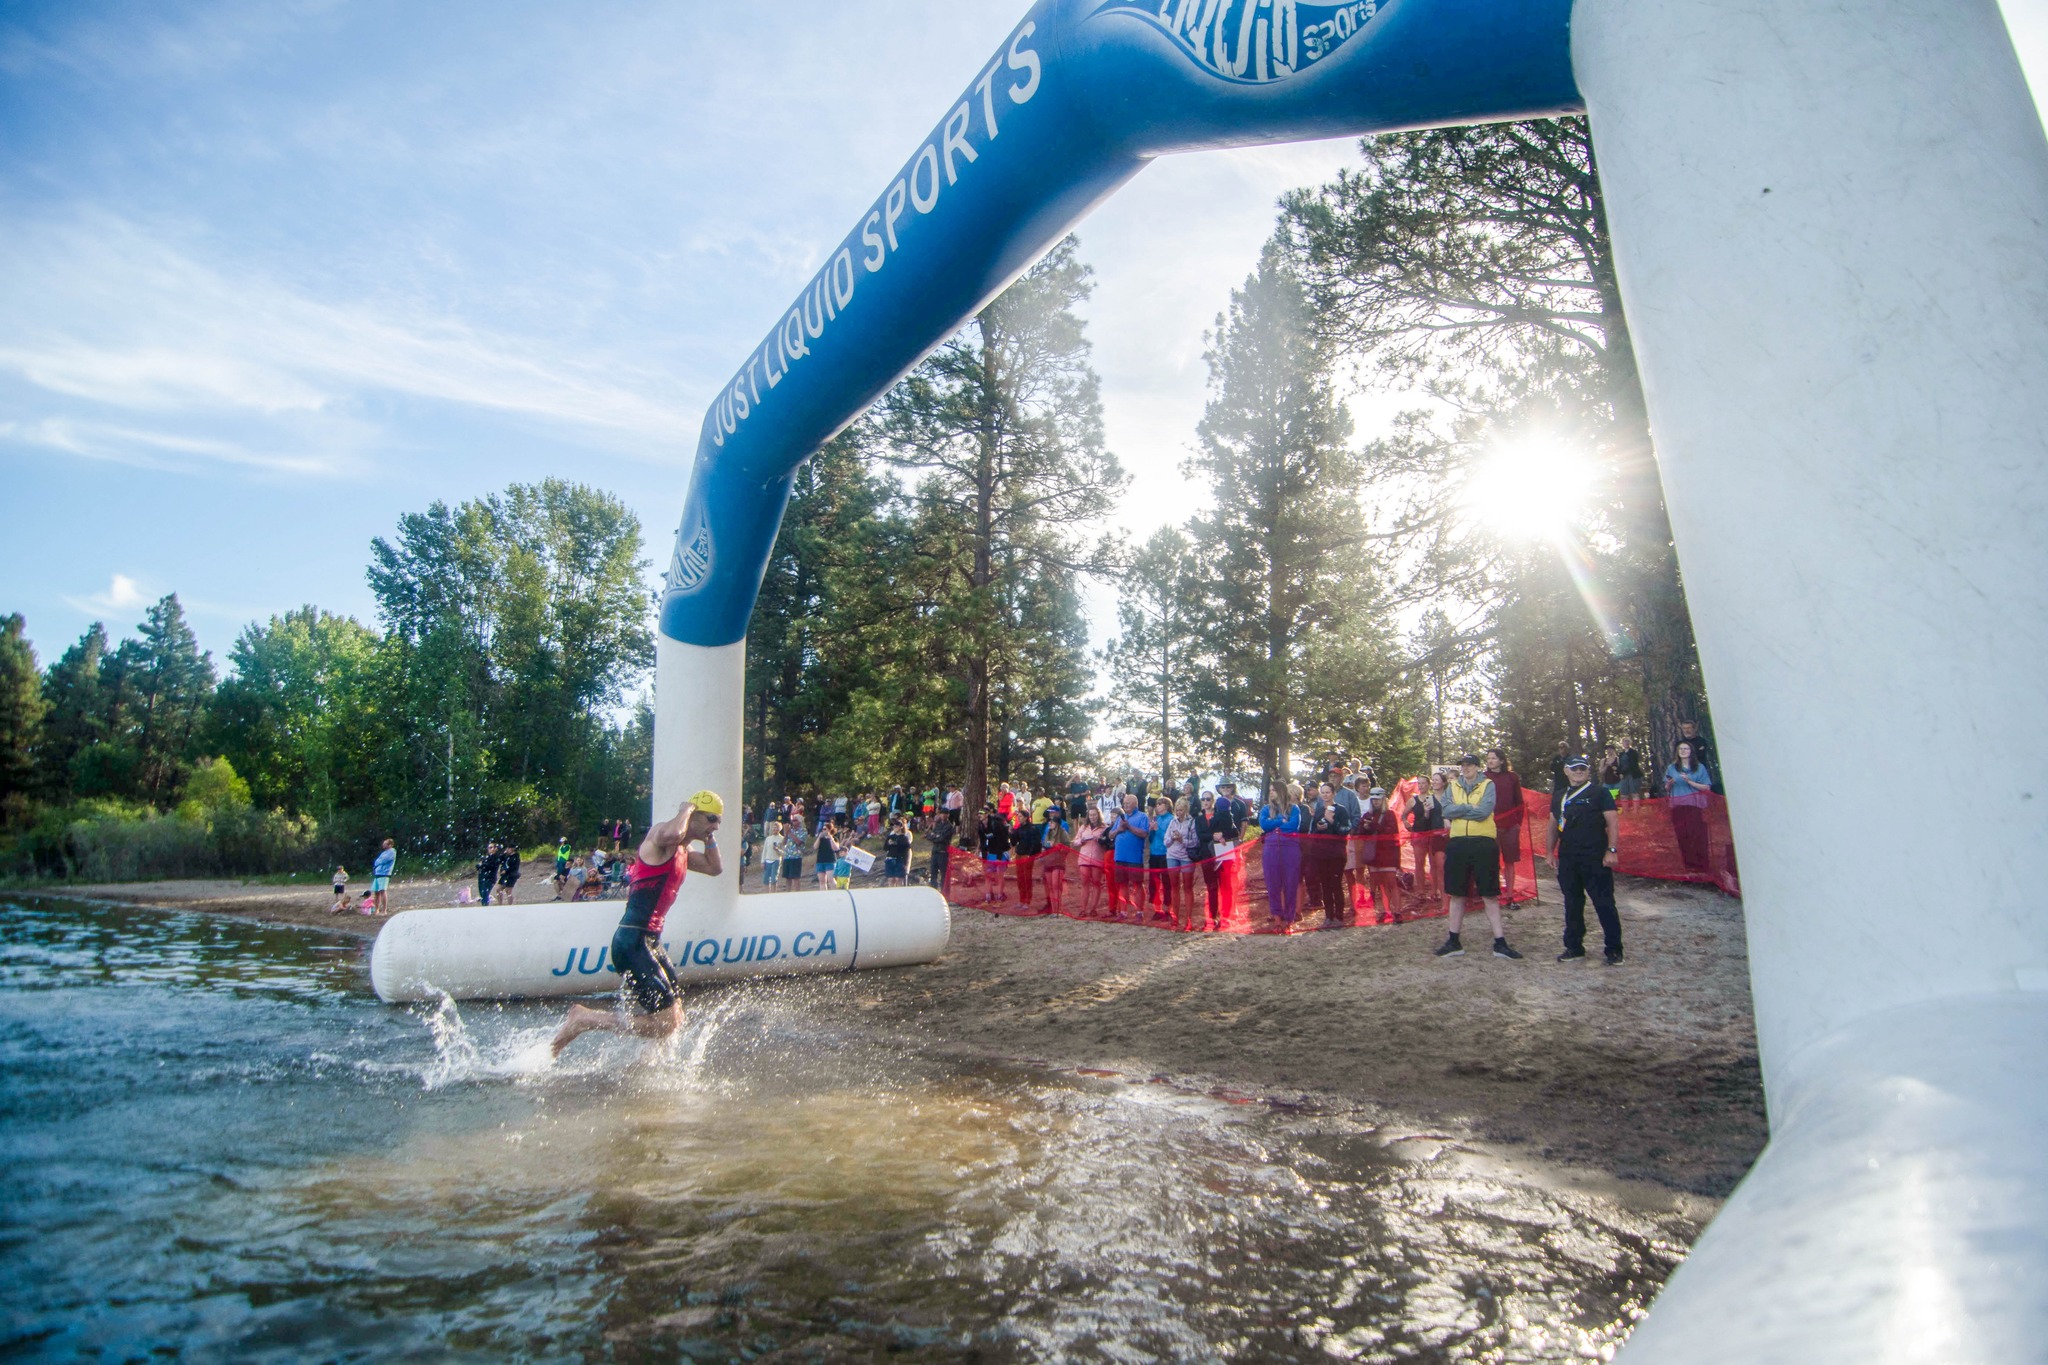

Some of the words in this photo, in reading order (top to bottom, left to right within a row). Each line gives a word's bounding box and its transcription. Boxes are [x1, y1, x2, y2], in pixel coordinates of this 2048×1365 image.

[713, 354, 760, 447] JUST
[764, 247, 855, 389] LIQUID
[862, 21, 1041, 273] SPORTS
[552, 929, 838, 977] JUIQUID.CA
